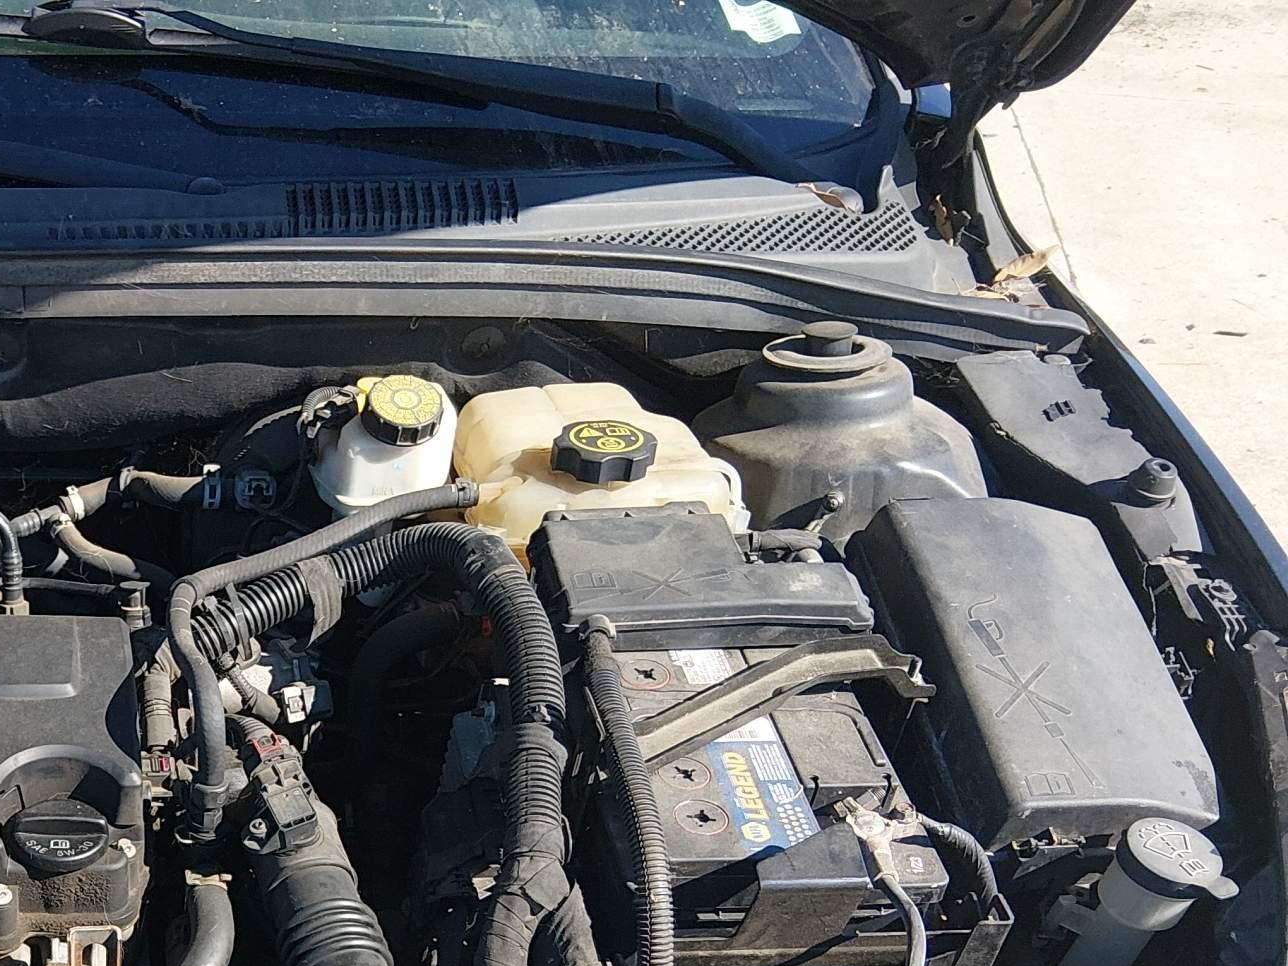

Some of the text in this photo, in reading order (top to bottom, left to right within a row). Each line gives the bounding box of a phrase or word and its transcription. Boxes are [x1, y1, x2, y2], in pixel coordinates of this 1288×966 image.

[721, 751, 770, 820] LEGEND
[25, 839, 95, 857] SAE 5W-30
